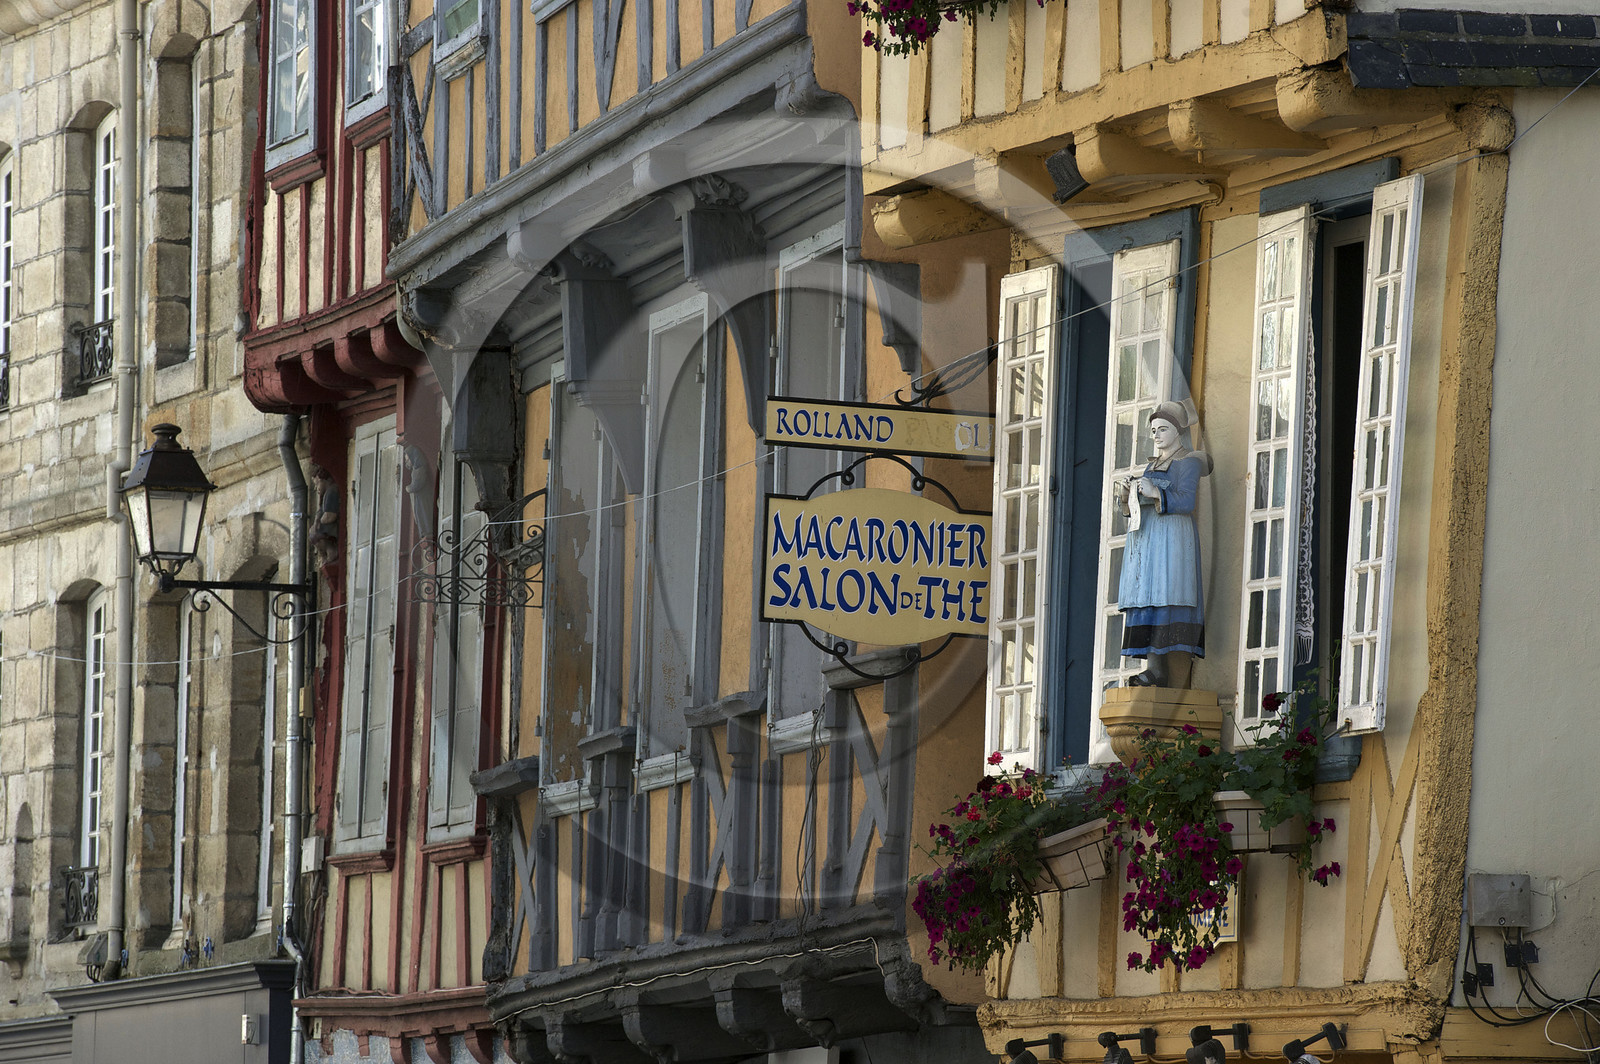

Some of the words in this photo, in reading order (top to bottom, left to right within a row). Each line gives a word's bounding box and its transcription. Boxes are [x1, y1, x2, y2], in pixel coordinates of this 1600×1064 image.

[776, 408, 894, 442] ROLLAND
[771, 509, 988, 570] MACARONIER
[768, 563, 900, 616] SALON
[900, 592, 922, 610] DE
[917, 575, 988, 624] THE
